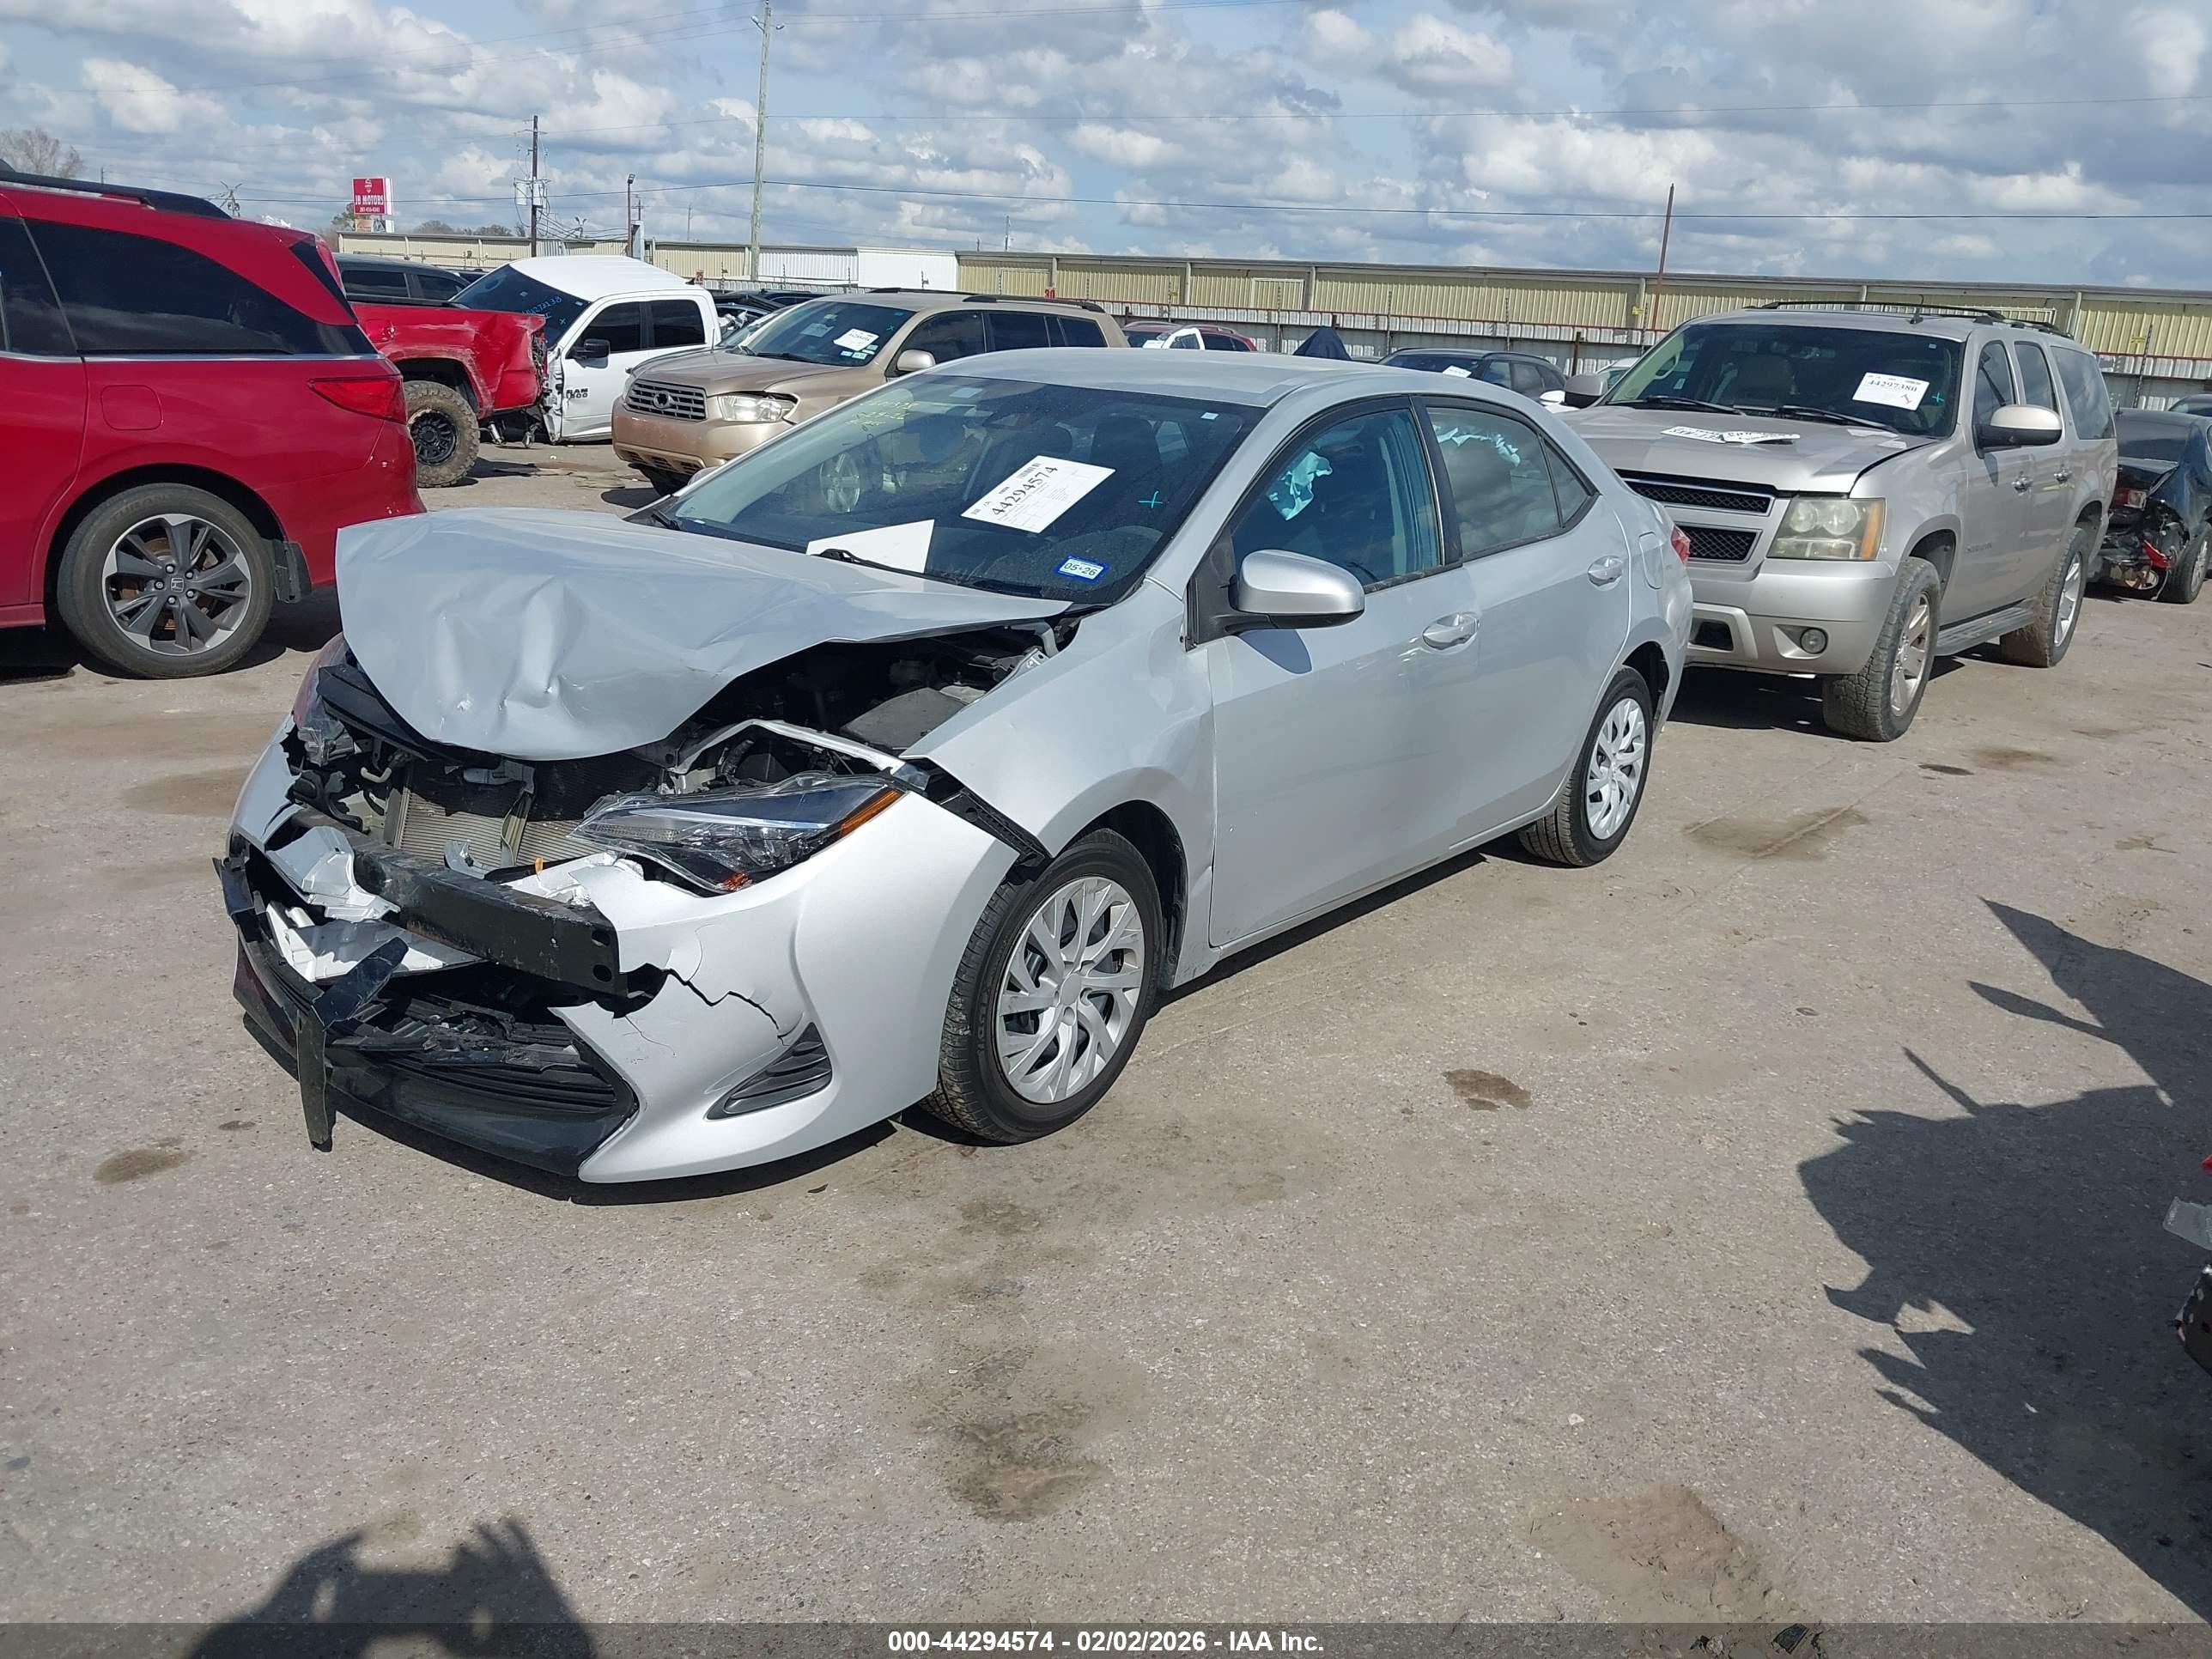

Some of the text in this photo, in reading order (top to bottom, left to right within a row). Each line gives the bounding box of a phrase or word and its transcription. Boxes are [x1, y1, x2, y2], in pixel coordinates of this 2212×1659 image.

[355, 194, 384, 205] JB MOTORS
[991, 466, 1058, 516] 44294574
